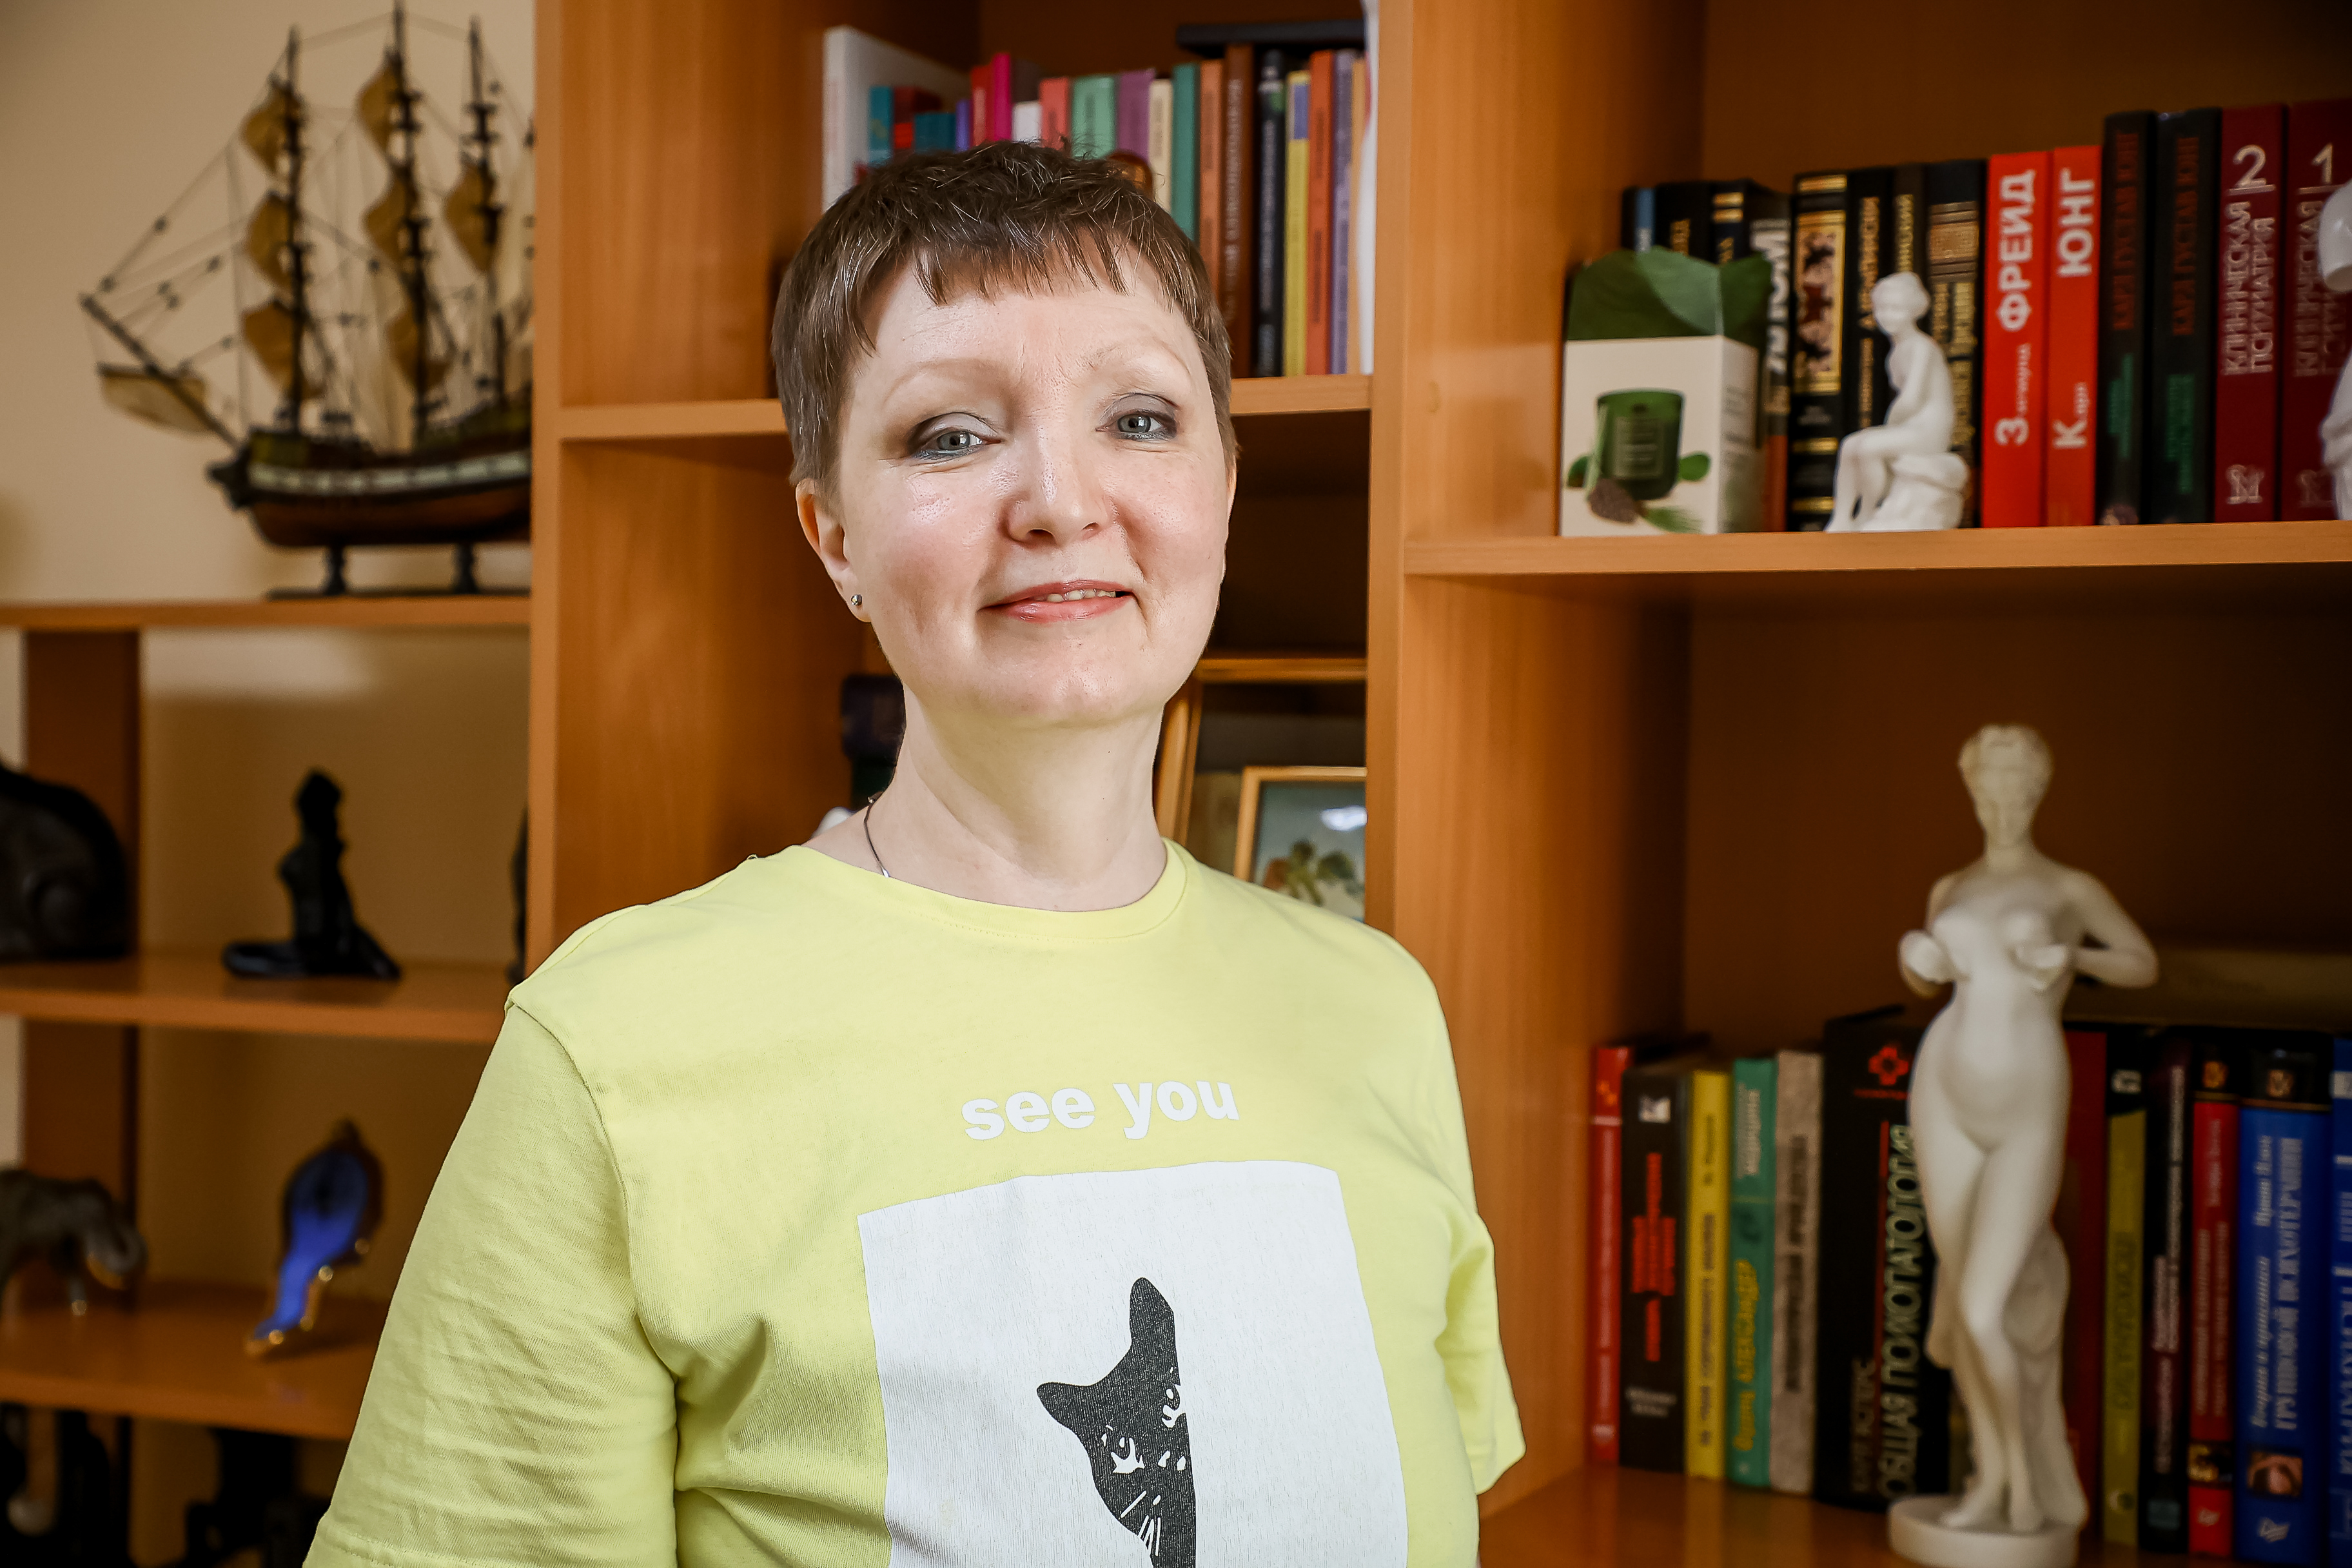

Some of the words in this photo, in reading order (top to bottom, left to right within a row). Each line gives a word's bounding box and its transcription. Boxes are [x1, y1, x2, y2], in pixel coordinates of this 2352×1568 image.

[2232, 144, 2267, 187] 2
[2312, 143, 2334, 184] 1
[2057, 168, 2095, 278] ЮНГ
[2222, 202, 2251, 375] КЛИНИЧЕСКАЯ
[2250, 217, 2276, 374] ПСИХИАТРИЯ
[961, 1087, 1096, 1141] see
[1112, 1080, 1240, 1140] you
[1877, 1393, 1923, 1498] ОБЩАЯ
